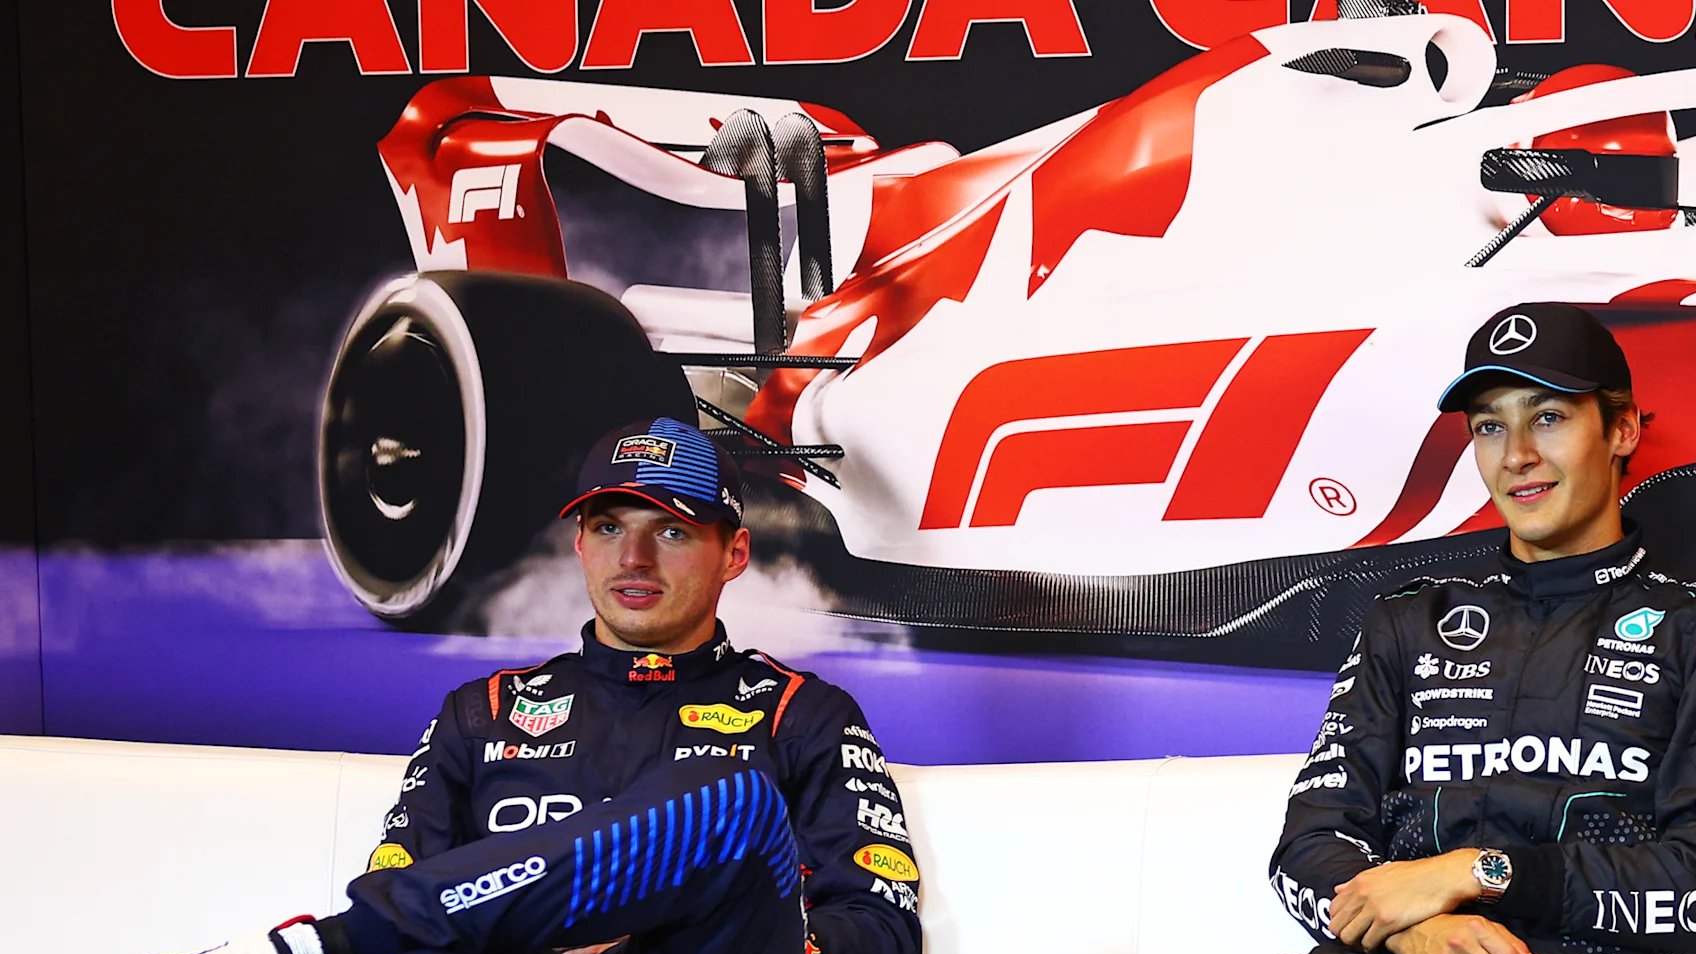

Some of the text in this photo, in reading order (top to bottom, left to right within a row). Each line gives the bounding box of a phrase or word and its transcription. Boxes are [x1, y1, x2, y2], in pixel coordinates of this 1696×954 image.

[449, 164, 522, 224] F1
[918, 328, 1376, 530] F1
[622, 439, 668, 449] ORACLE
[1597, 638, 1655, 655] PETRONAS
[628, 670, 676, 682] Red Bull
[1444, 660, 1491, 680] UBS
[1584, 654, 1661, 684] INEOS
[1414, 687, 1493, 702] CROWDSTRIKE
[520, 700, 568, 715] TAG
[513, 712, 567, 735] HEUER
[701, 711, 754, 727] RAUCH
[1422, 715, 1487, 730] Snapdragon
[484, 741, 551, 763] Mobil
[1405, 735, 1651, 784] PETRONAS
[374, 855, 406, 867] AUCH
[873, 853, 912, 877] RAUCH
[440, 856, 548, 912] sparco
